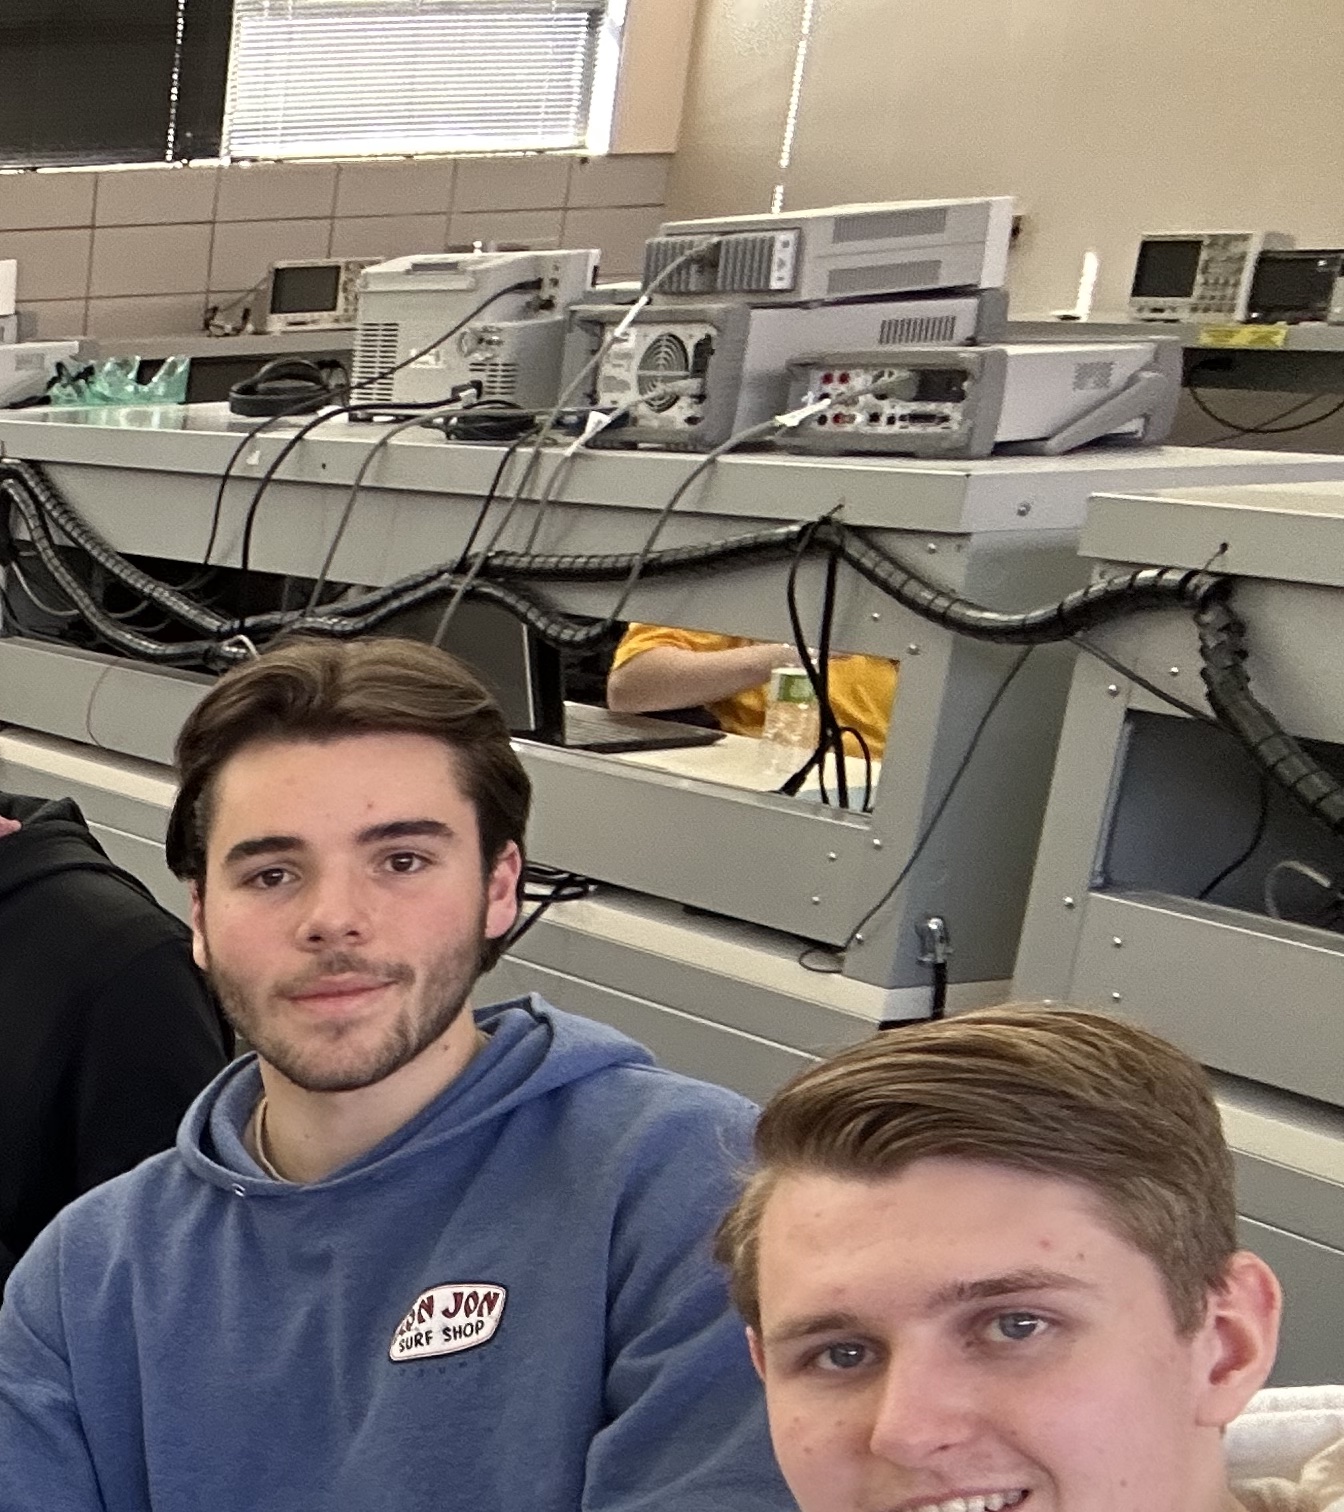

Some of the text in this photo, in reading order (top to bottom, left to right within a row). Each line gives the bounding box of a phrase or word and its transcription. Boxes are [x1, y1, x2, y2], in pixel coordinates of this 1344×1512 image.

[441, 1290, 500, 1318] JON
[399, 1319, 484, 1353] SURF SHOP
